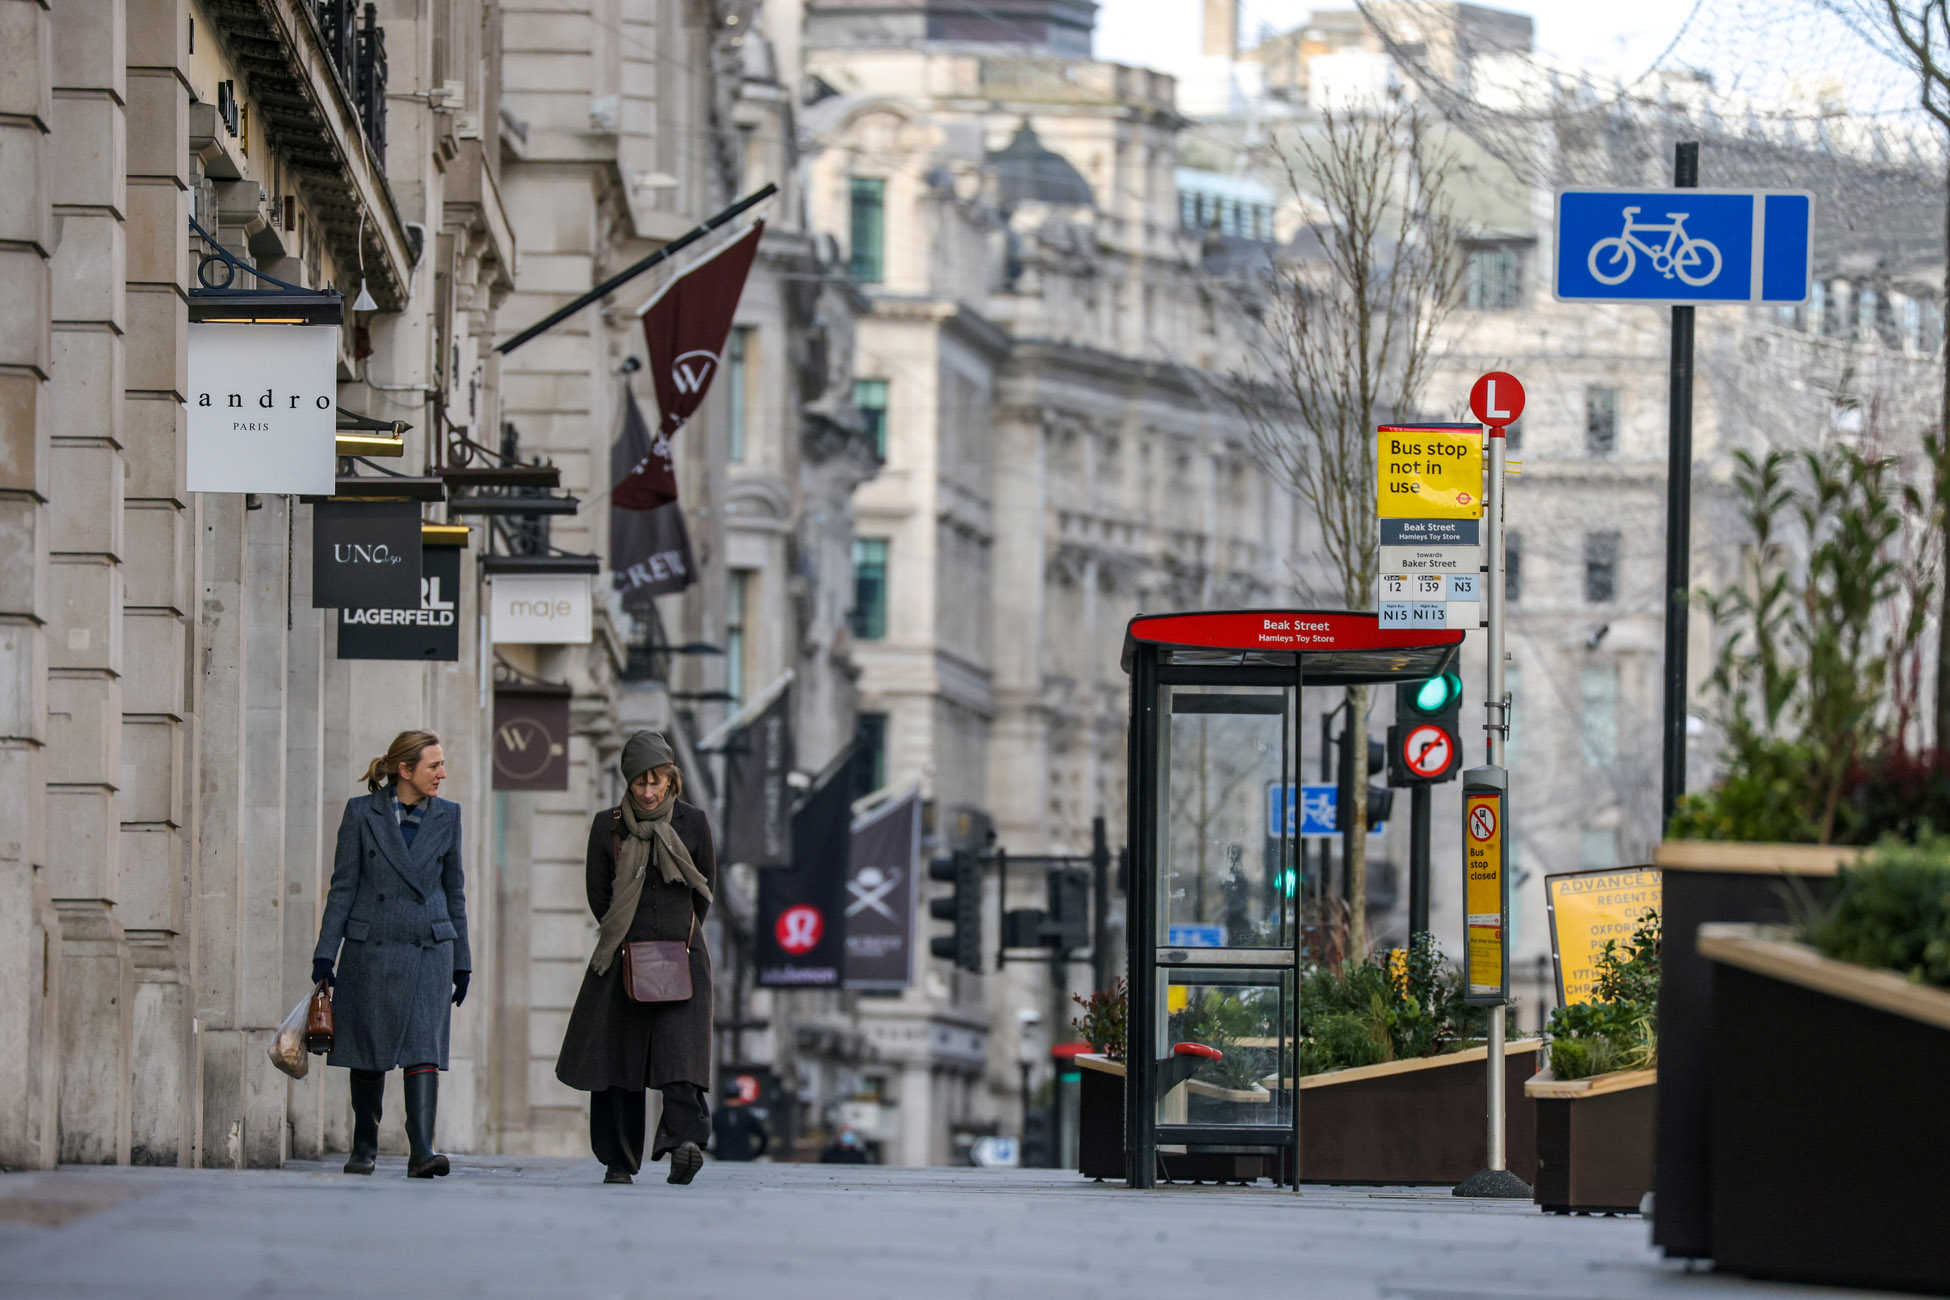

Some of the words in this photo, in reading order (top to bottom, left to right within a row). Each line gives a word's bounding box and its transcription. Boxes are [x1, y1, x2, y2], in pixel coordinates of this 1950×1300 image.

[198, 389, 331, 410] andro
[1486, 380, 1511, 419] L
[233, 422, 270, 431] PARIS
[1391, 440, 1422, 455] Bus
[1427, 442, 1467, 460] stop
[1390, 460, 1421, 475] not
[1426, 460, 1442, 475] in
[1390, 482, 1421, 494] use
[1403, 522, 1426, 532] Beak
[1427, 523, 1456, 532] Street
[1398, 533, 1428, 542] Hamleys
[1430, 534, 1441, 542] Toy
[1402, 559, 1427, 568] Baker
[1429, 559, 1457, 568] Street
[1389, 581, 1402, 592] 12
[1419, 581, 1440, 592] 139
[1454, 582, 1472, 592] N3
[509, 596, 572, 620] maje
[343, 608, 455, 626] LAGERFELD
[1383, 611, 1408, 621] N15
[1413, 610, 1445, 620] N113
[1263, 619, 1291, 630] Beak
[1294, 620, 1330, 631] Street
[1258, 634, 1294, 643] Hamleys
[1296, 634, 1311, 644] Toy
[1312, 635, 1335, 643] Store
[1470, 848, 1485, 857] Bus
[1470, 860, 1489, 870] stop
[1470, 871, 1497, 881] closed
[1559, 874, 1646, 893] ADVANCE
[1597, 891, 1647, 906] REGENT
[1590, 922, 1640, 936] OXFORD
[1572, 969, 1600, 980] 17TH
